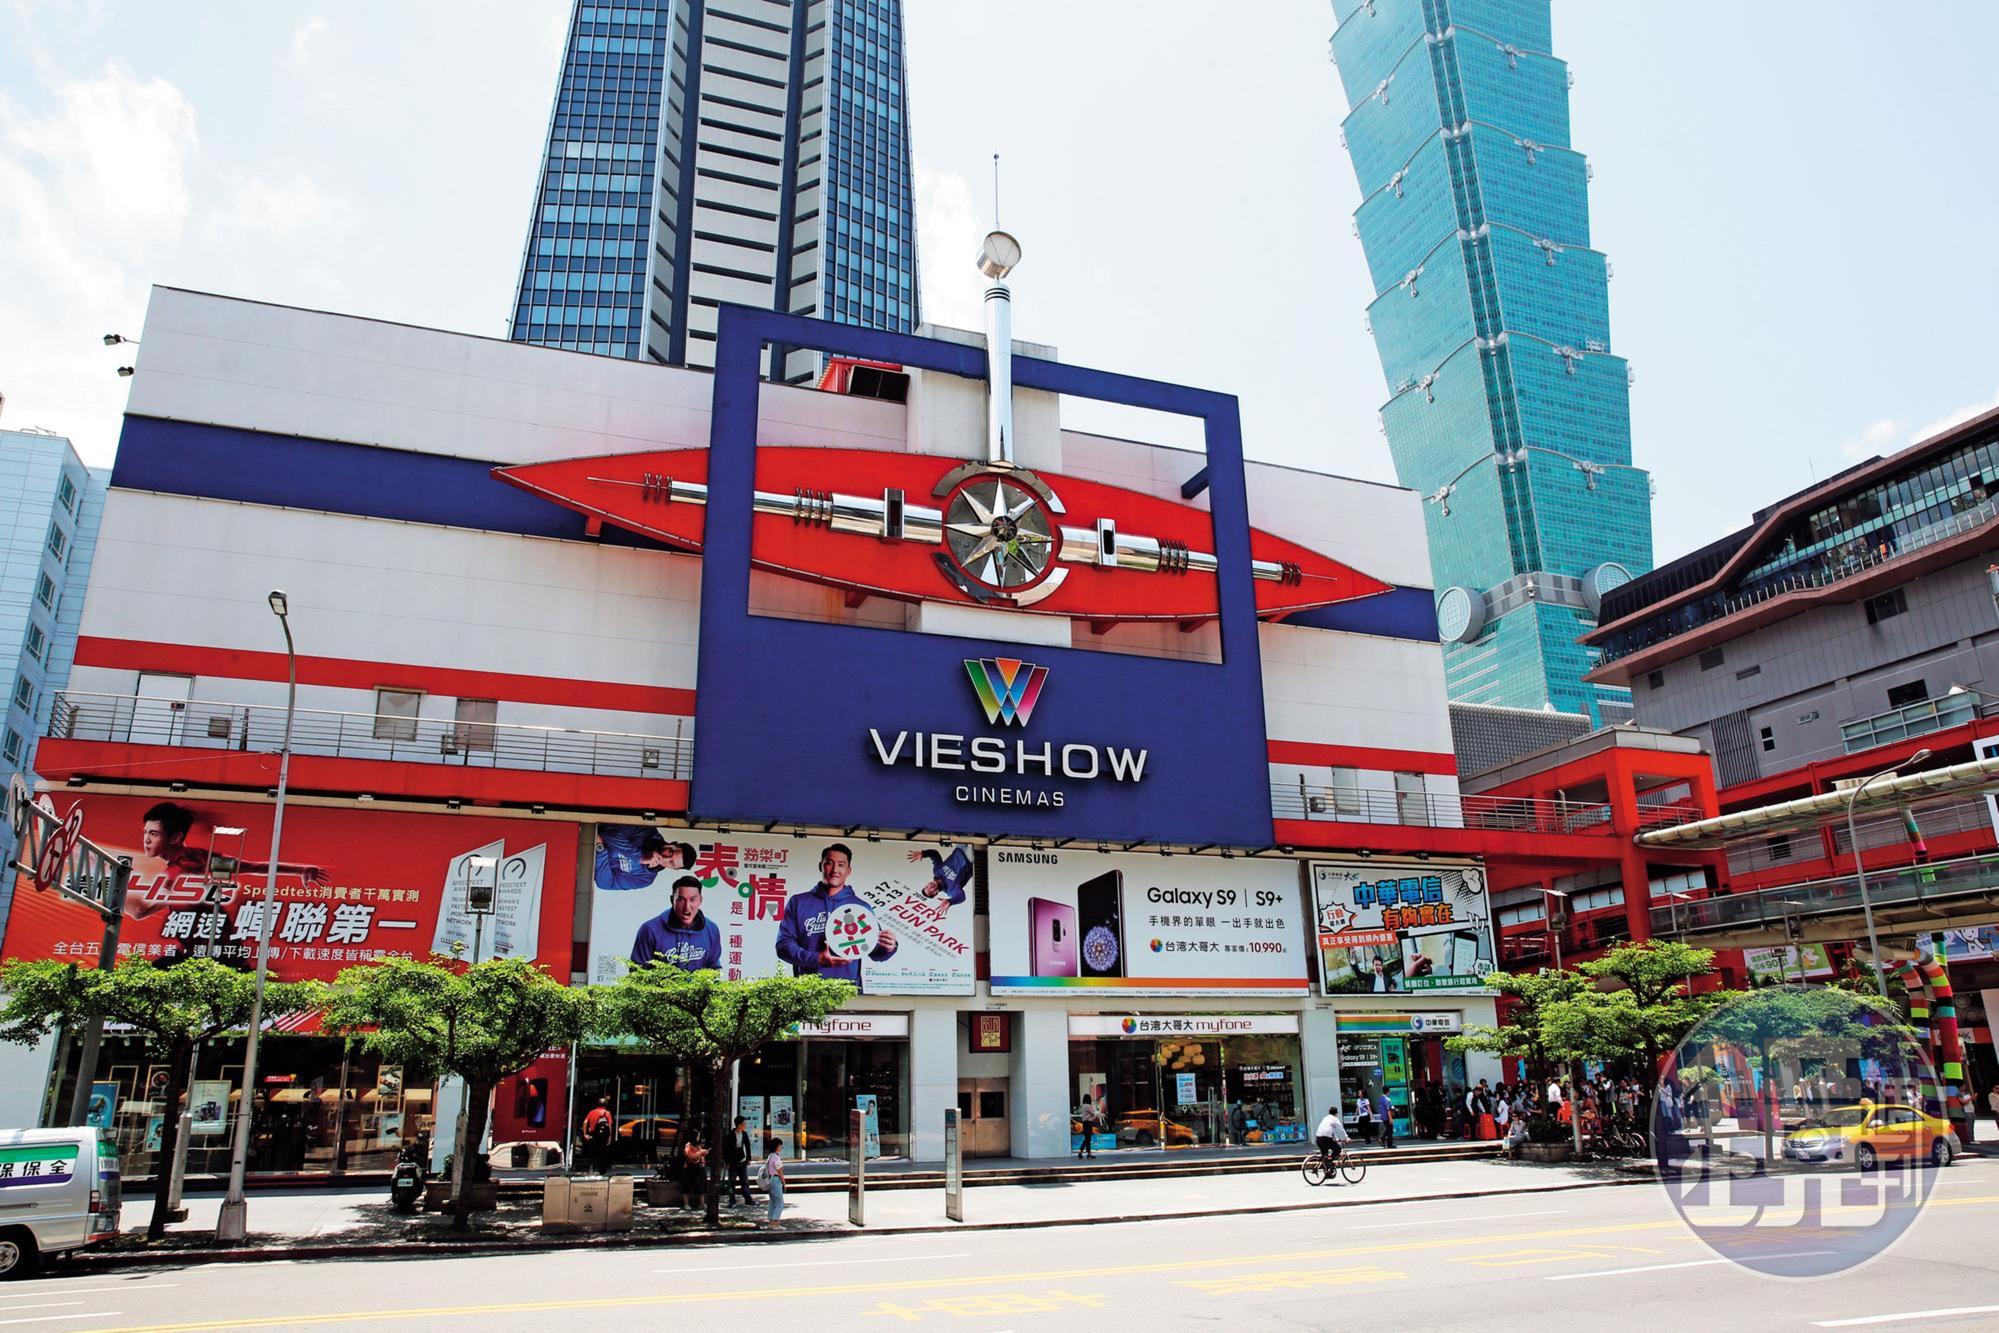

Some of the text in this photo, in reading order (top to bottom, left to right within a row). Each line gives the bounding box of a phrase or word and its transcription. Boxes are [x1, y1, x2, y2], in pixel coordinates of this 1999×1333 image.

[869, 728, 1148, 783] VIESHOW
[956, 785, 1065, 807] CINEMAS
[744, 848, 789, 863] 粉樂町
[998, 852, 1059, 865] SAMSUNG
[863, 881, 891, 899] 3.17
[1147, 887, 1283, 909] Galaxy S9 S9+
[1352, 877, 1444, 910] 中華電信
[889, 904, 927, 928] FUN
[904, 895, 946, 923] VERY
[1382, 903, 1455, 931] 有夠實在
[161, 910, 227, 939] 網速
[229, 900, 416, 944] 蟬聯第一
[1149, 915, 1286, 929] 手機界的單眼 一出手就出色
[802, 1019, 872, 1034] myfone
[1196, 1019, 1252, 1032] myfone
